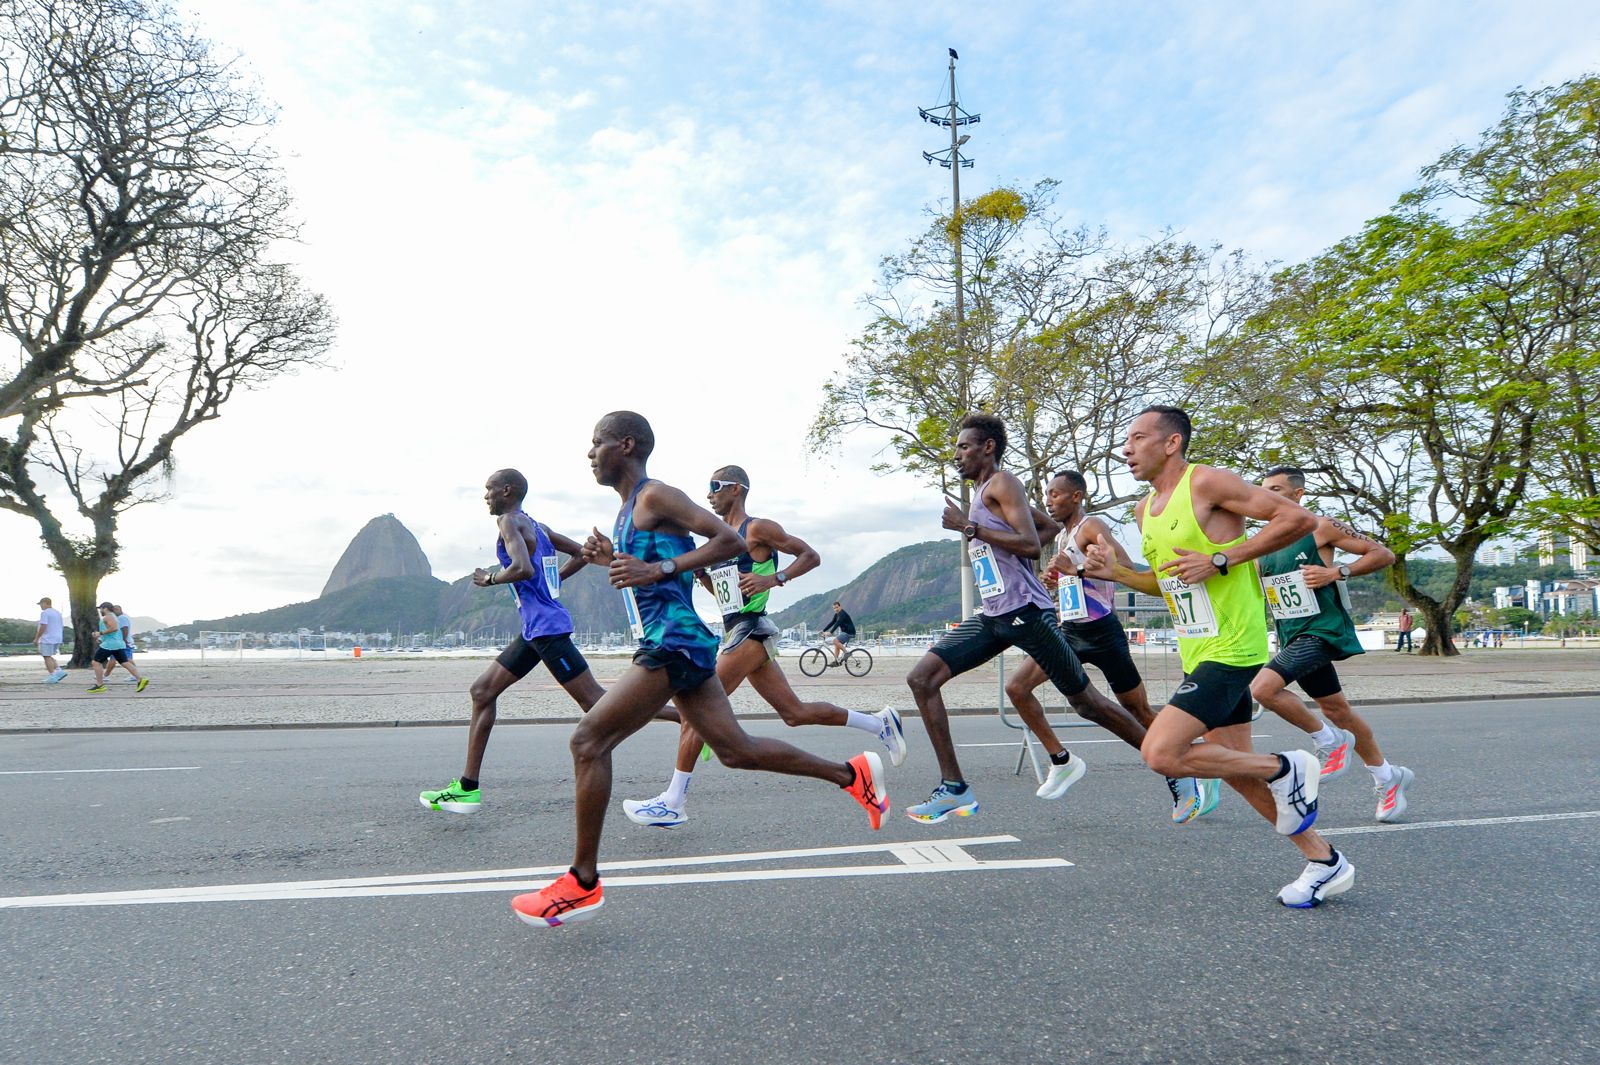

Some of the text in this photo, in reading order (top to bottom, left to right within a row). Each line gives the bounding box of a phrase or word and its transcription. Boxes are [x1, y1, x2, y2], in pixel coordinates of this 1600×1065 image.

[975, 561, 989, 586] 2
[1162, 579, 1189, 591] LUCAS
[1271, 575, 1292, 586] JOSE
[716, 580, 730, 605] 68
[1064, 587, 1073, 609] 3
[1280, 584, 1302, 608] 65
[1174, 592, 1196, 624] 67
